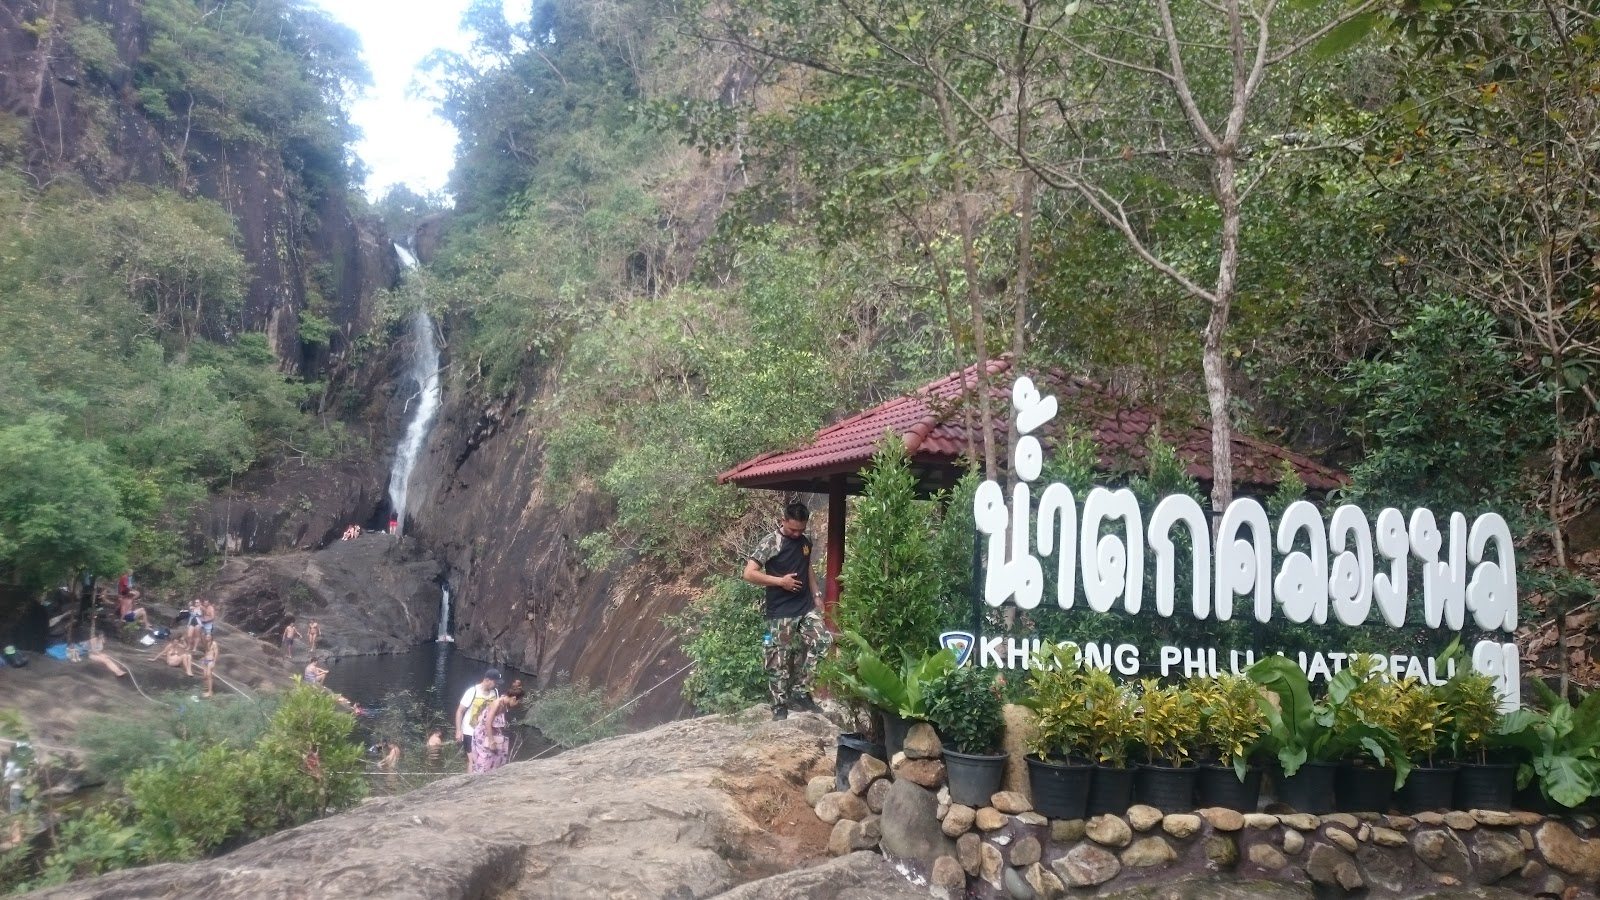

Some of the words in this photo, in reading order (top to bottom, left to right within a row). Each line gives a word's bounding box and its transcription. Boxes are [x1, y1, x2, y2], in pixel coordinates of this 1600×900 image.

[980, 636, 1140, 675] KHLONG
[1160, 645, 1255, 679] PHLU
[1276, 651, 1456, 687] ATRFAL
